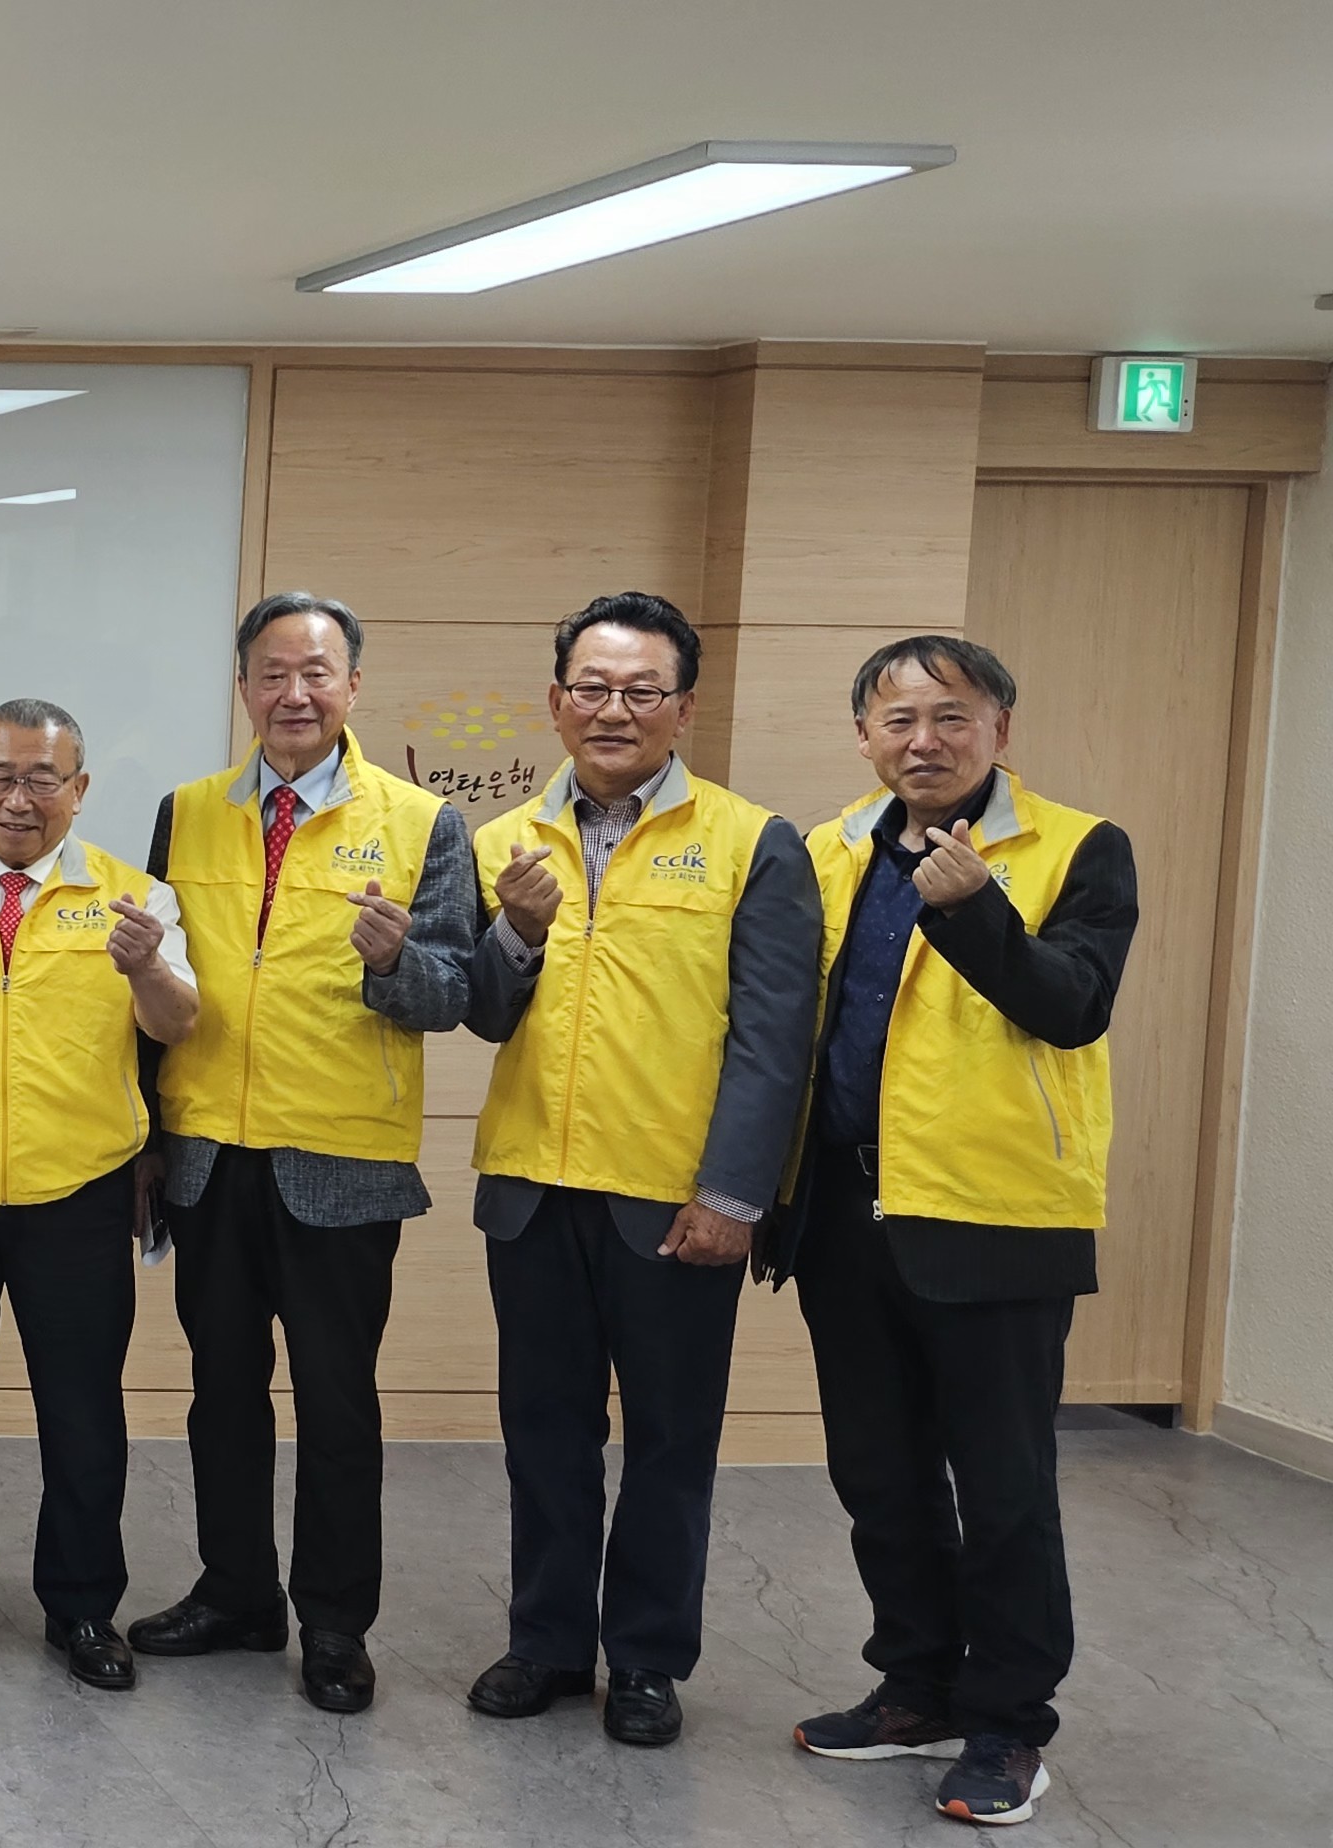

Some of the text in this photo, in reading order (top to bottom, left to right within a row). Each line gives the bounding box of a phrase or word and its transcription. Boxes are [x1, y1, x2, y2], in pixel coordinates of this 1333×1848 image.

[429, 757, 536, 803] 연탄은행
[335, 845, 385, 862] CCIK
[653, 855, 707, 868] CCIK
[57, 908, 106, 921] CCIK
